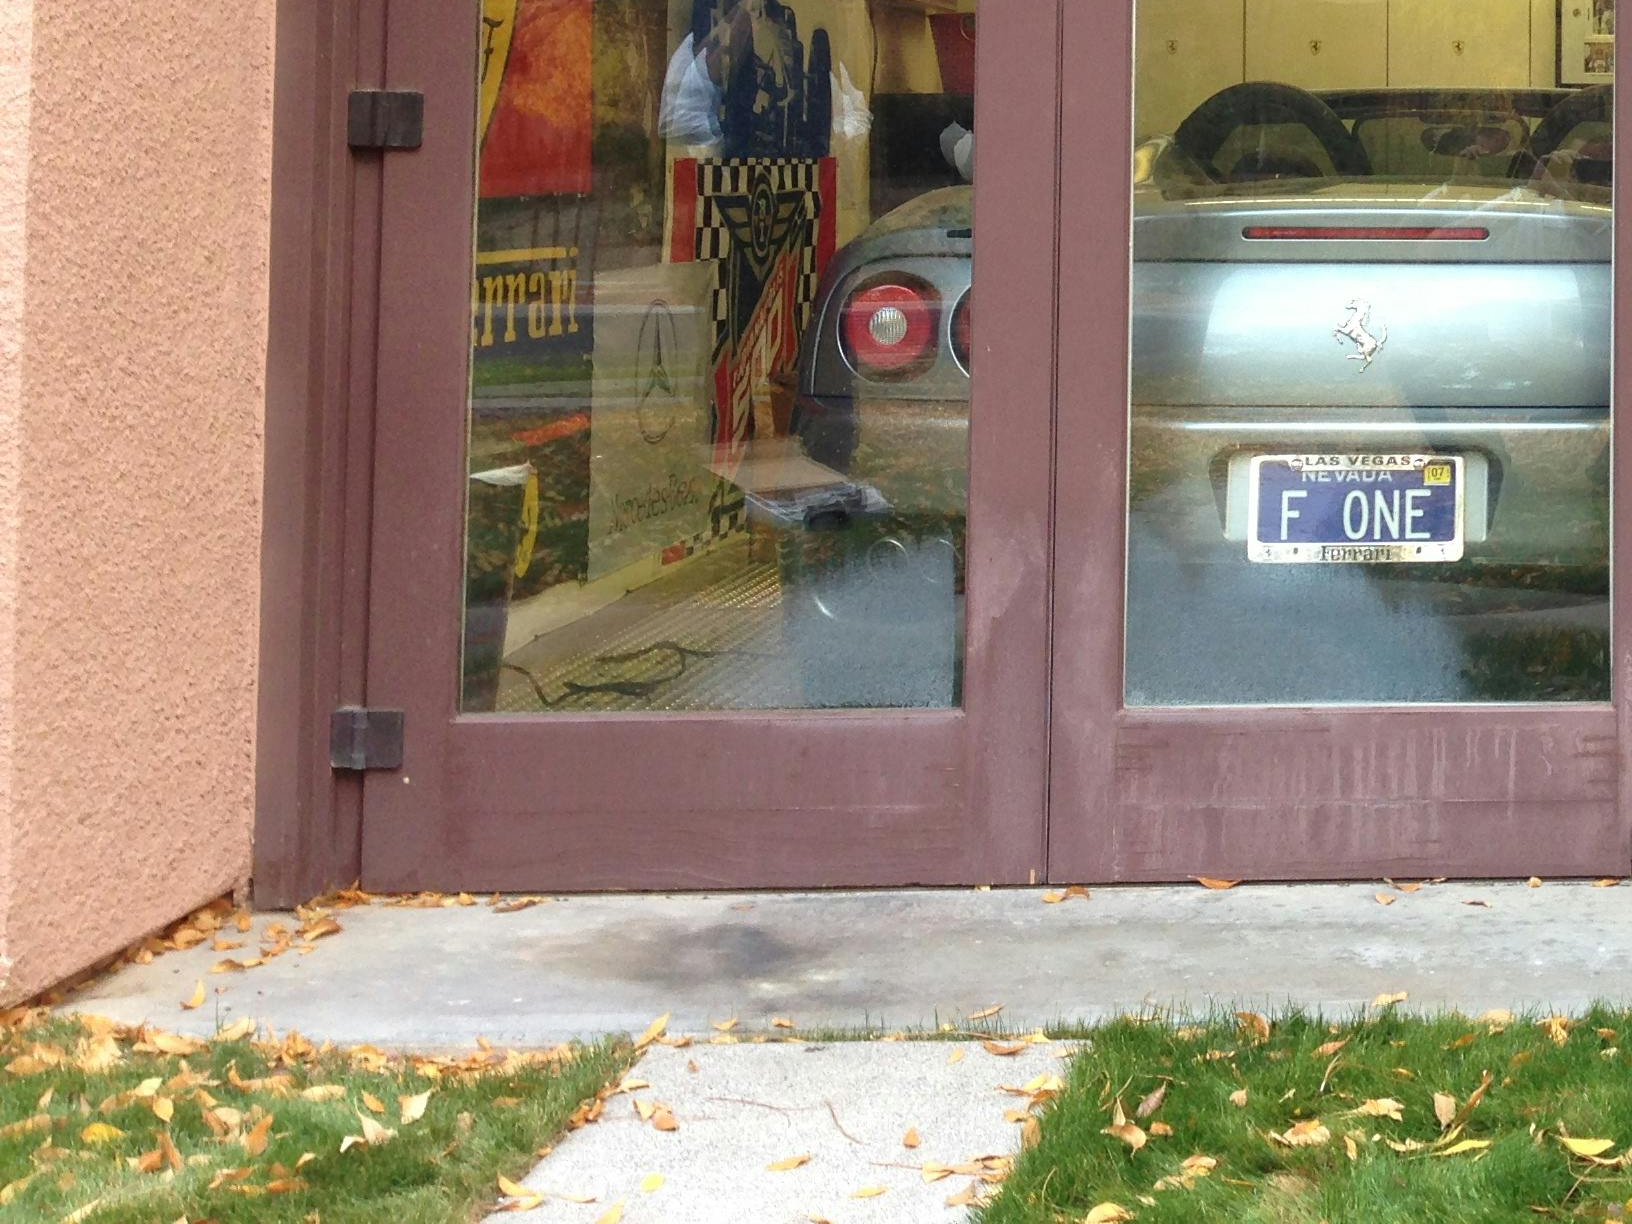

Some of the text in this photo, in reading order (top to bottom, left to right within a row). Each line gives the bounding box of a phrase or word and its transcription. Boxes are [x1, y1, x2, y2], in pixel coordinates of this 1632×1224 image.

[1305, 455, 1411, 466] LAS VEGAS
[1431, 467, 1445, 478] 07
[1280, 489, 1432, 541] F ONE
[1319, 544, 1392, 562] Ferrari
